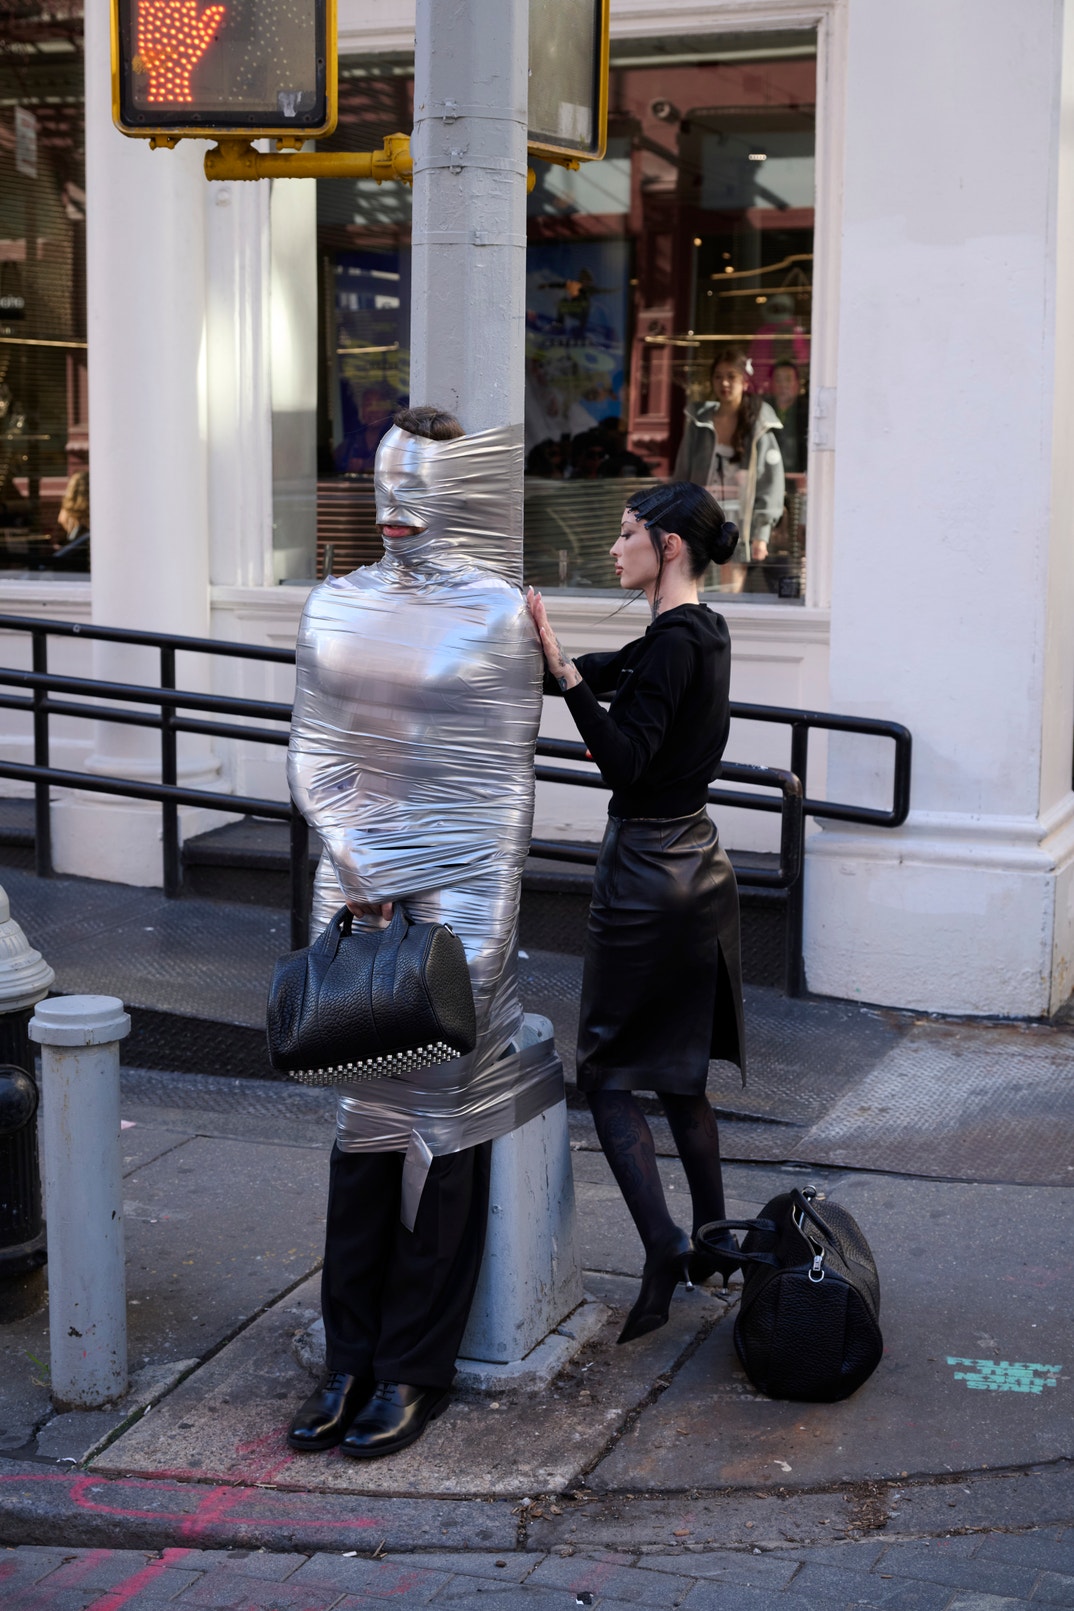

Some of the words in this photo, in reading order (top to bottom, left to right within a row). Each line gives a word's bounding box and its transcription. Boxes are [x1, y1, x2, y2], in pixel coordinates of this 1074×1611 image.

[946, 1357, 1062, 1372] FOLLOW
[954, 1372, 1056, 1387] NORTH
[966, 1381, 1043, 1394] STAR
